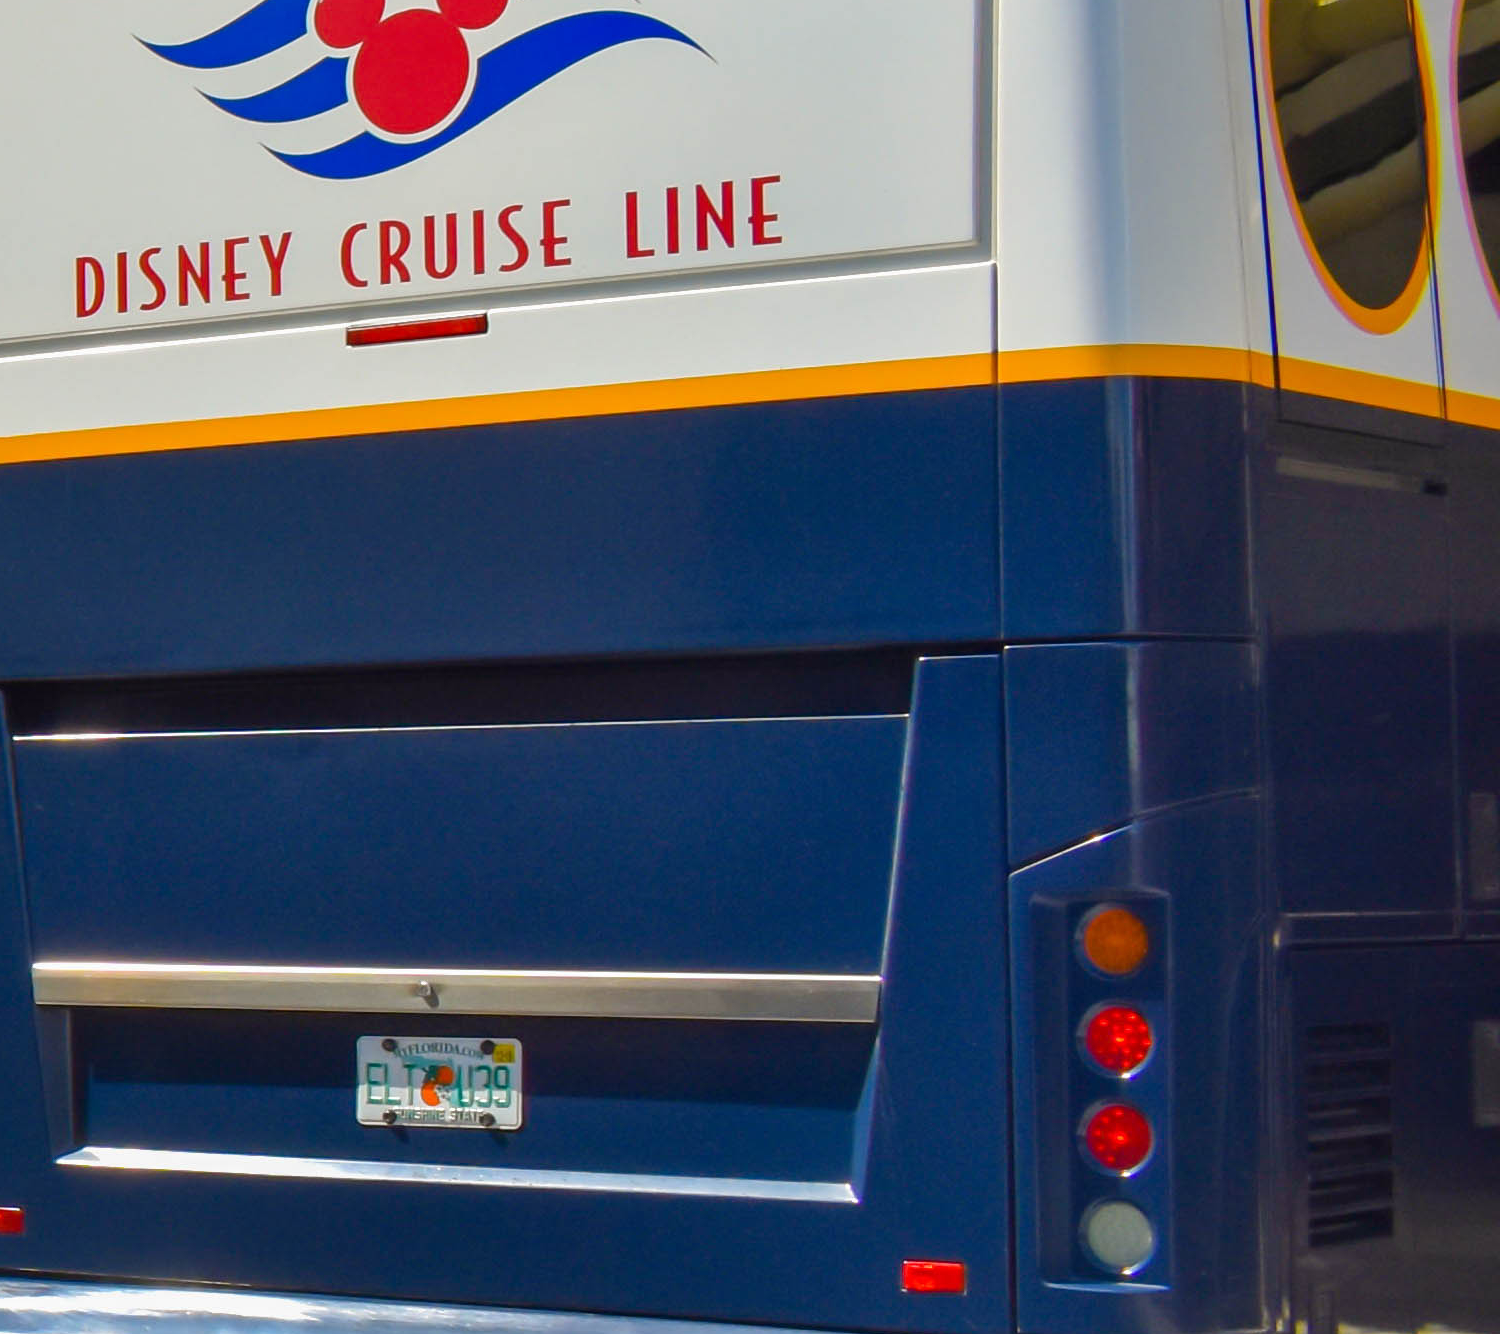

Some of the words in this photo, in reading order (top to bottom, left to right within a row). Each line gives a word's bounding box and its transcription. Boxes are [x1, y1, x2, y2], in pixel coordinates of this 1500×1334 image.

[74, 230, 293, 319] DISNEY
[340, 198, 573, 289] CRUISE
[624, 174, 784, 259] LINE
[366, 1063, 418, 1106] ELT
[457, 1065, 512, 1108] U39
